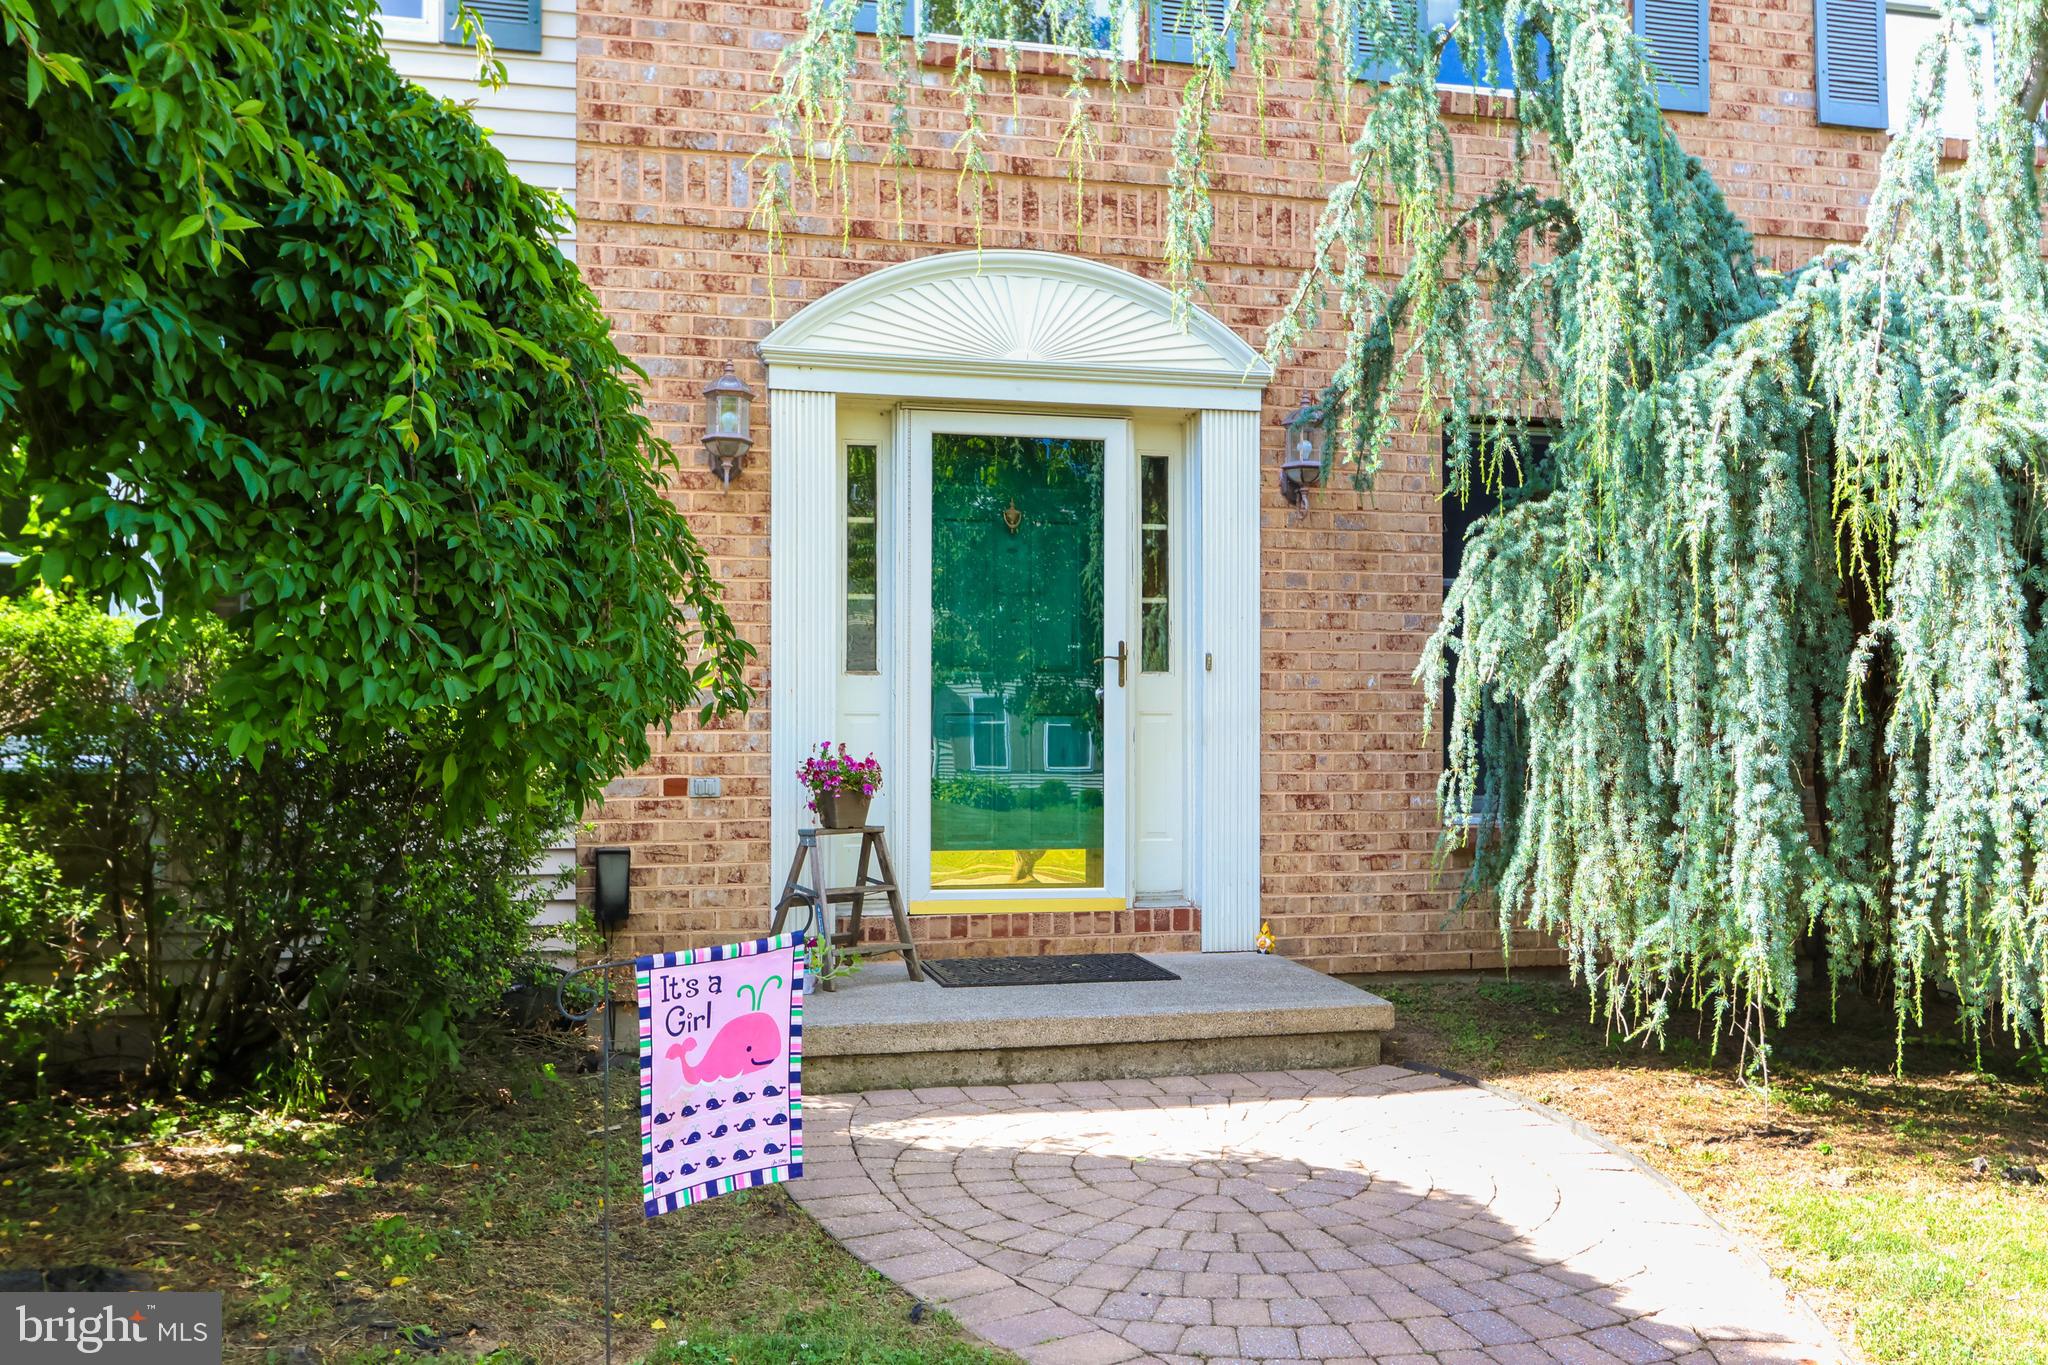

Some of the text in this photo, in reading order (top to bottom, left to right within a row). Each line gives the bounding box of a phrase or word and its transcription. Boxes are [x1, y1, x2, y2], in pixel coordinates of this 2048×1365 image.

[660, 975, 722, 1003] It's a
[665, 1001, 711, 1037] Girl
